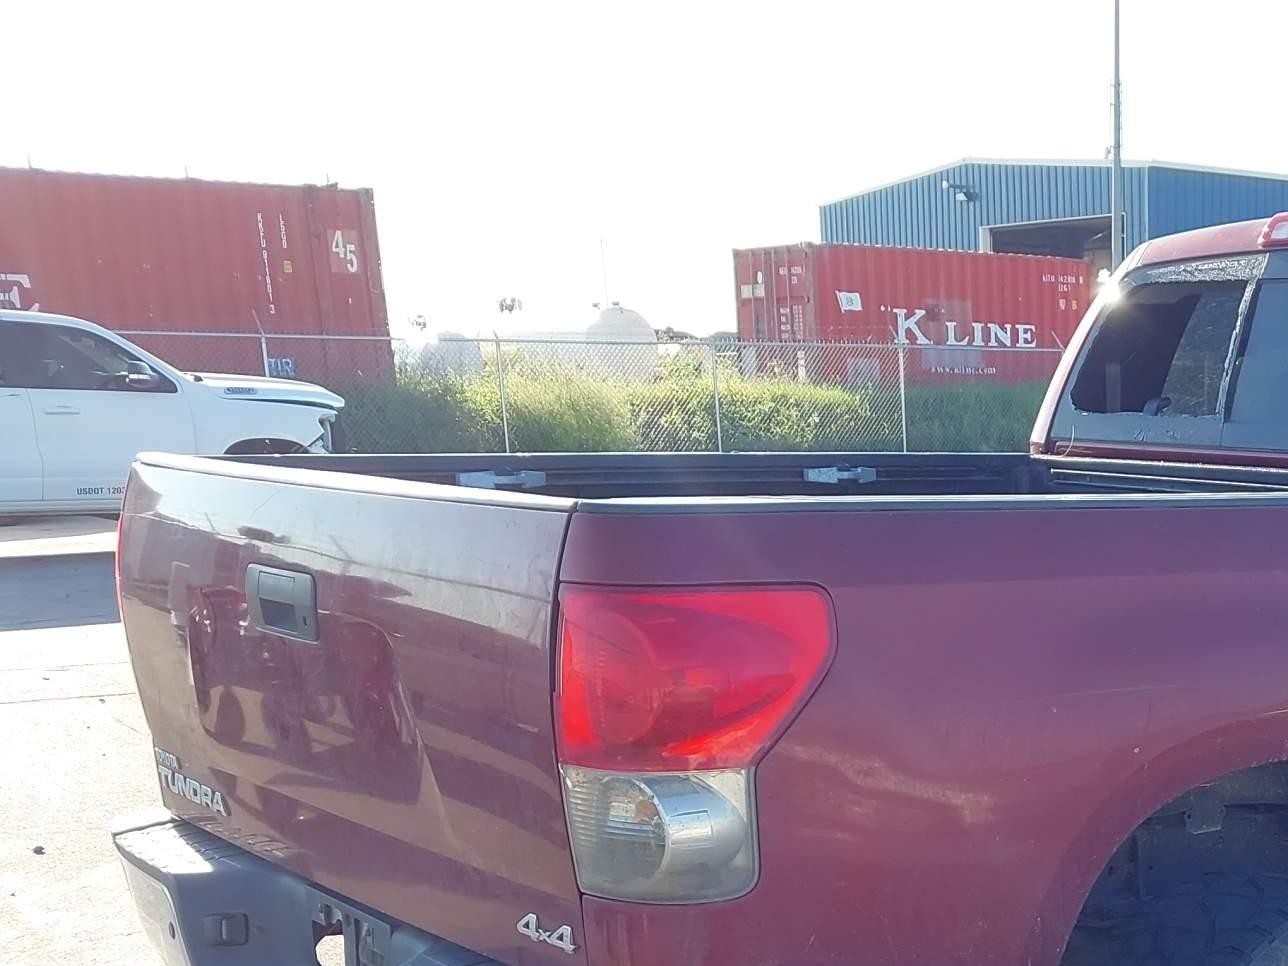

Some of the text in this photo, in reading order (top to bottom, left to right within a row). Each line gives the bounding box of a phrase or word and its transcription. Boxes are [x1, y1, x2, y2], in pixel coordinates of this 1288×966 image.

[332, 230, 358, 272] 45
[945, 321, 1037, 348] LINE
[267, 358, 294, 377] TIR
[76, 486, 105, 496] USDOT
[159, 764, 228, 817] TUNDRA
[516, 912, 577, 955] 4x4
